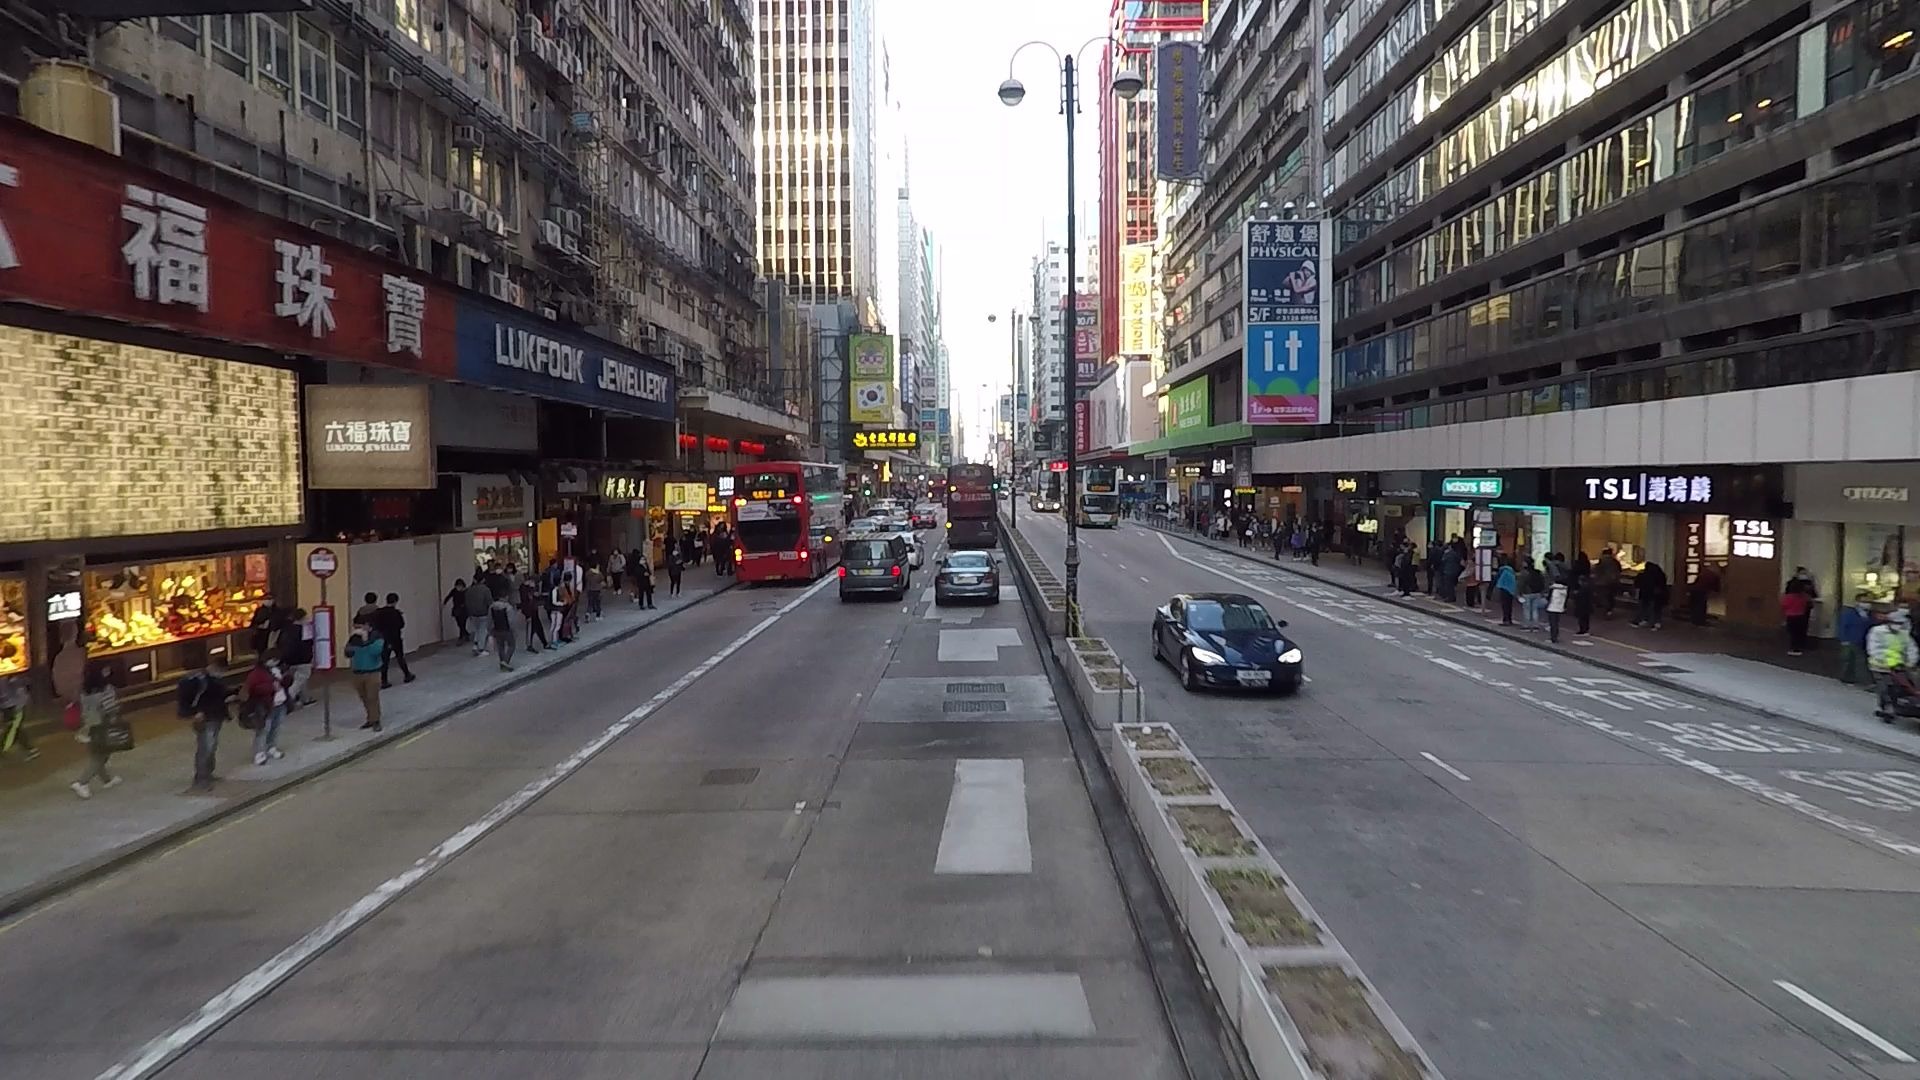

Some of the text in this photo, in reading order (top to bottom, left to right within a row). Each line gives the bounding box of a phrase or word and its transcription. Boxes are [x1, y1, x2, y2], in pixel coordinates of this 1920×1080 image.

[1251, 225, 1318, 243] 舒適堡
[1251, 246, 1318, 257] PHYSICAL
[1077, 316, 1096, 326] 10/F
[1250, 307, 1271, 321] 5/F
[1264, 330, 1302, 372] i.t
[495, 322, 668, 403] LUKFOOK JEWELLERY
[324, 420, 412, 443] 六福珠寶
[1585, 478, 1637, 500] TSL
[1733, 519, 1774, 536] TSL
[1688, 523, 1700, 557] TSL
[1645, 718, 1844, 752] STOP
